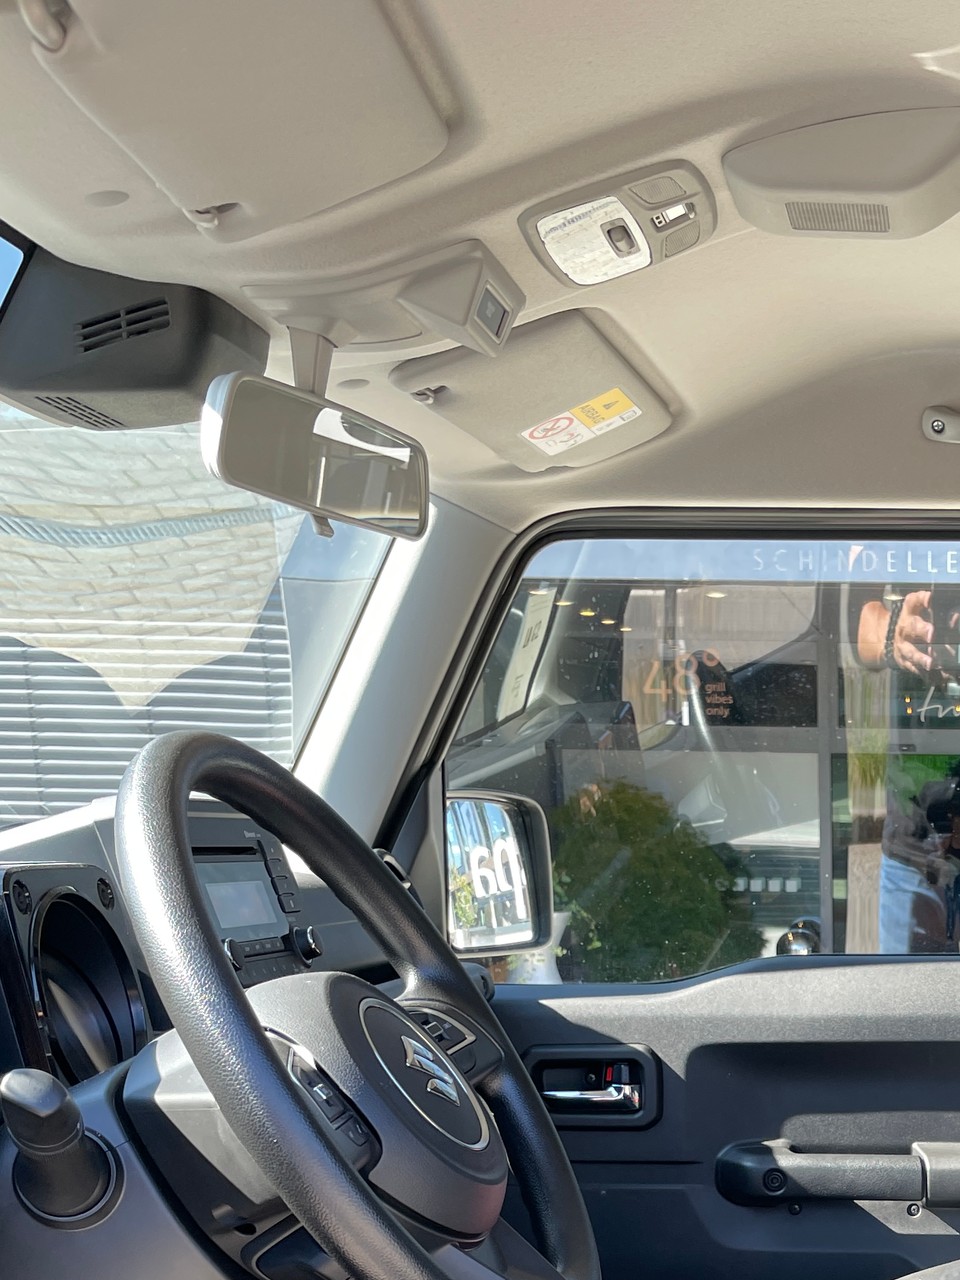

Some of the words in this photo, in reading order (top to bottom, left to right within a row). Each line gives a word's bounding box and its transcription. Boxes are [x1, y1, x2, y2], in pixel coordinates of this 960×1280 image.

[705, 682, 726, 693] grill
[705, 694, 733, 704] vibes
[706, 706, 730, 718] only
